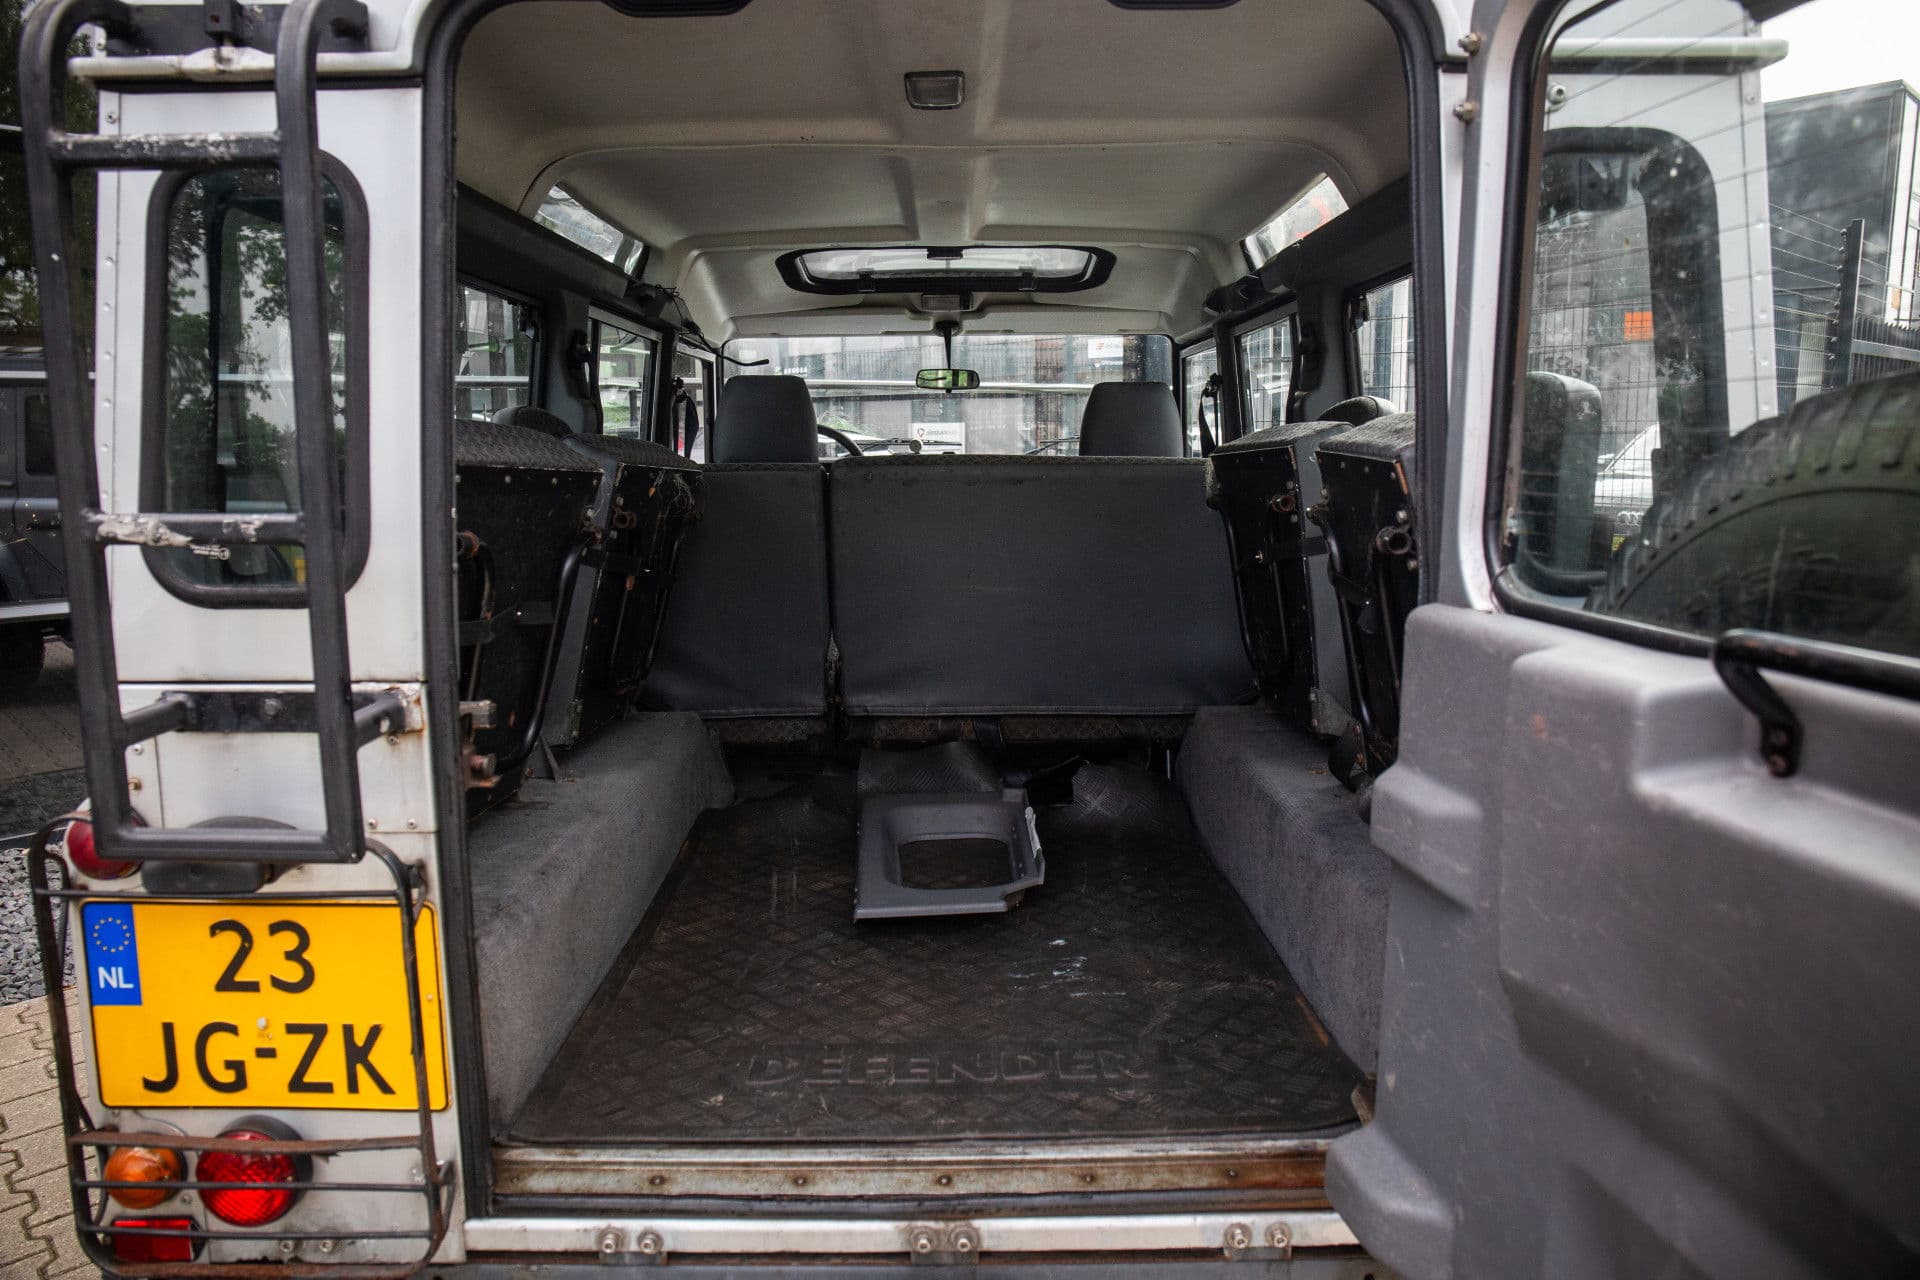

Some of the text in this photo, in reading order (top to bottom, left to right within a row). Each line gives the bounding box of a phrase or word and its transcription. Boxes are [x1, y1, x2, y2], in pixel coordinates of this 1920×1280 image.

[97, 965, 135, 990] NL
[208, 919, 316, 994] 23
[142, 1021, 397, 1095] JG-ZK
[745, 1048, 1152, 1086] DEFENDER
